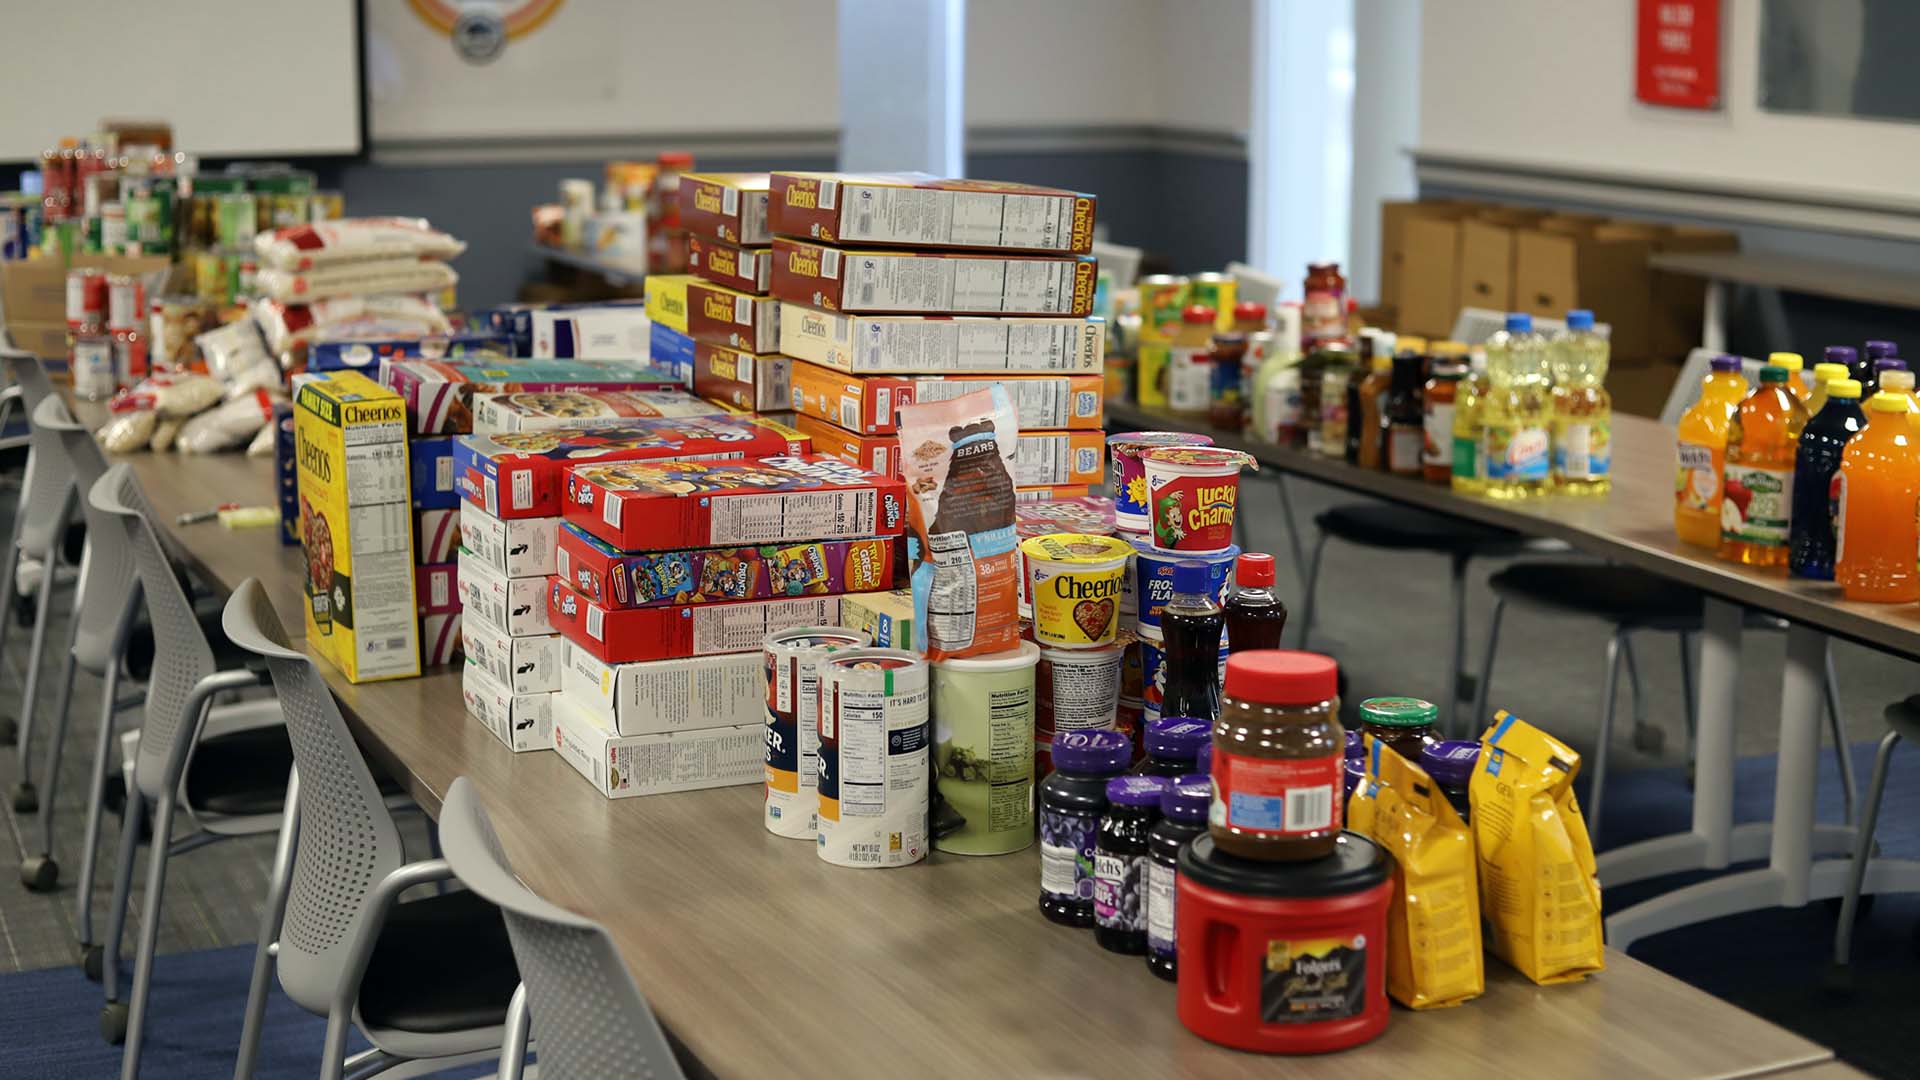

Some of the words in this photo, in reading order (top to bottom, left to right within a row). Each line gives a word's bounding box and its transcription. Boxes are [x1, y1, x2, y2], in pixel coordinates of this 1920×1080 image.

[786, 185, 816, 209] Cheerios
[1073, 198, 1090, 251] Cheerios
[789, 252, 819, 277] Cheerios
[1074, 262, 1091, 314] Cheerios
[1084, 325, 1096, 368] Cheerios
[345, 406, 402, 423] Cheerios
[298, 424, 331, 483] Cheerios
[956, 441, 994, 458] BEARS
[1196, 485, 1236, 506] Lucky
[866, 492, 874, 521] Nutrition
[884, 494, 896, 529] CRUNCH
[866, 521, 874, 533] Facts
[1188, 506, 1235, 532] Charms
[868, 542, 878, 561] TRY
[951, 556, 962, 565] 210
[807, 545, 824, 579] CRUNCH
[859, 549, 872, 583] GREAT
[870, 560, 881, 578] ALL
[736, 562, 749, 597] CRUNCH
[871, 578, 880, 587] 3
[1150, 590, 1174, 600] FLA
[882, 618, 889, 634] 8
[890, 698, 902, 707] IT'S
[902, 695, 917, 705] HARD
[991, 691, 1016, 699] Nutrition
[872, 710, 883, 719] 150
[1295, 959, 1342, 976] Folgers
